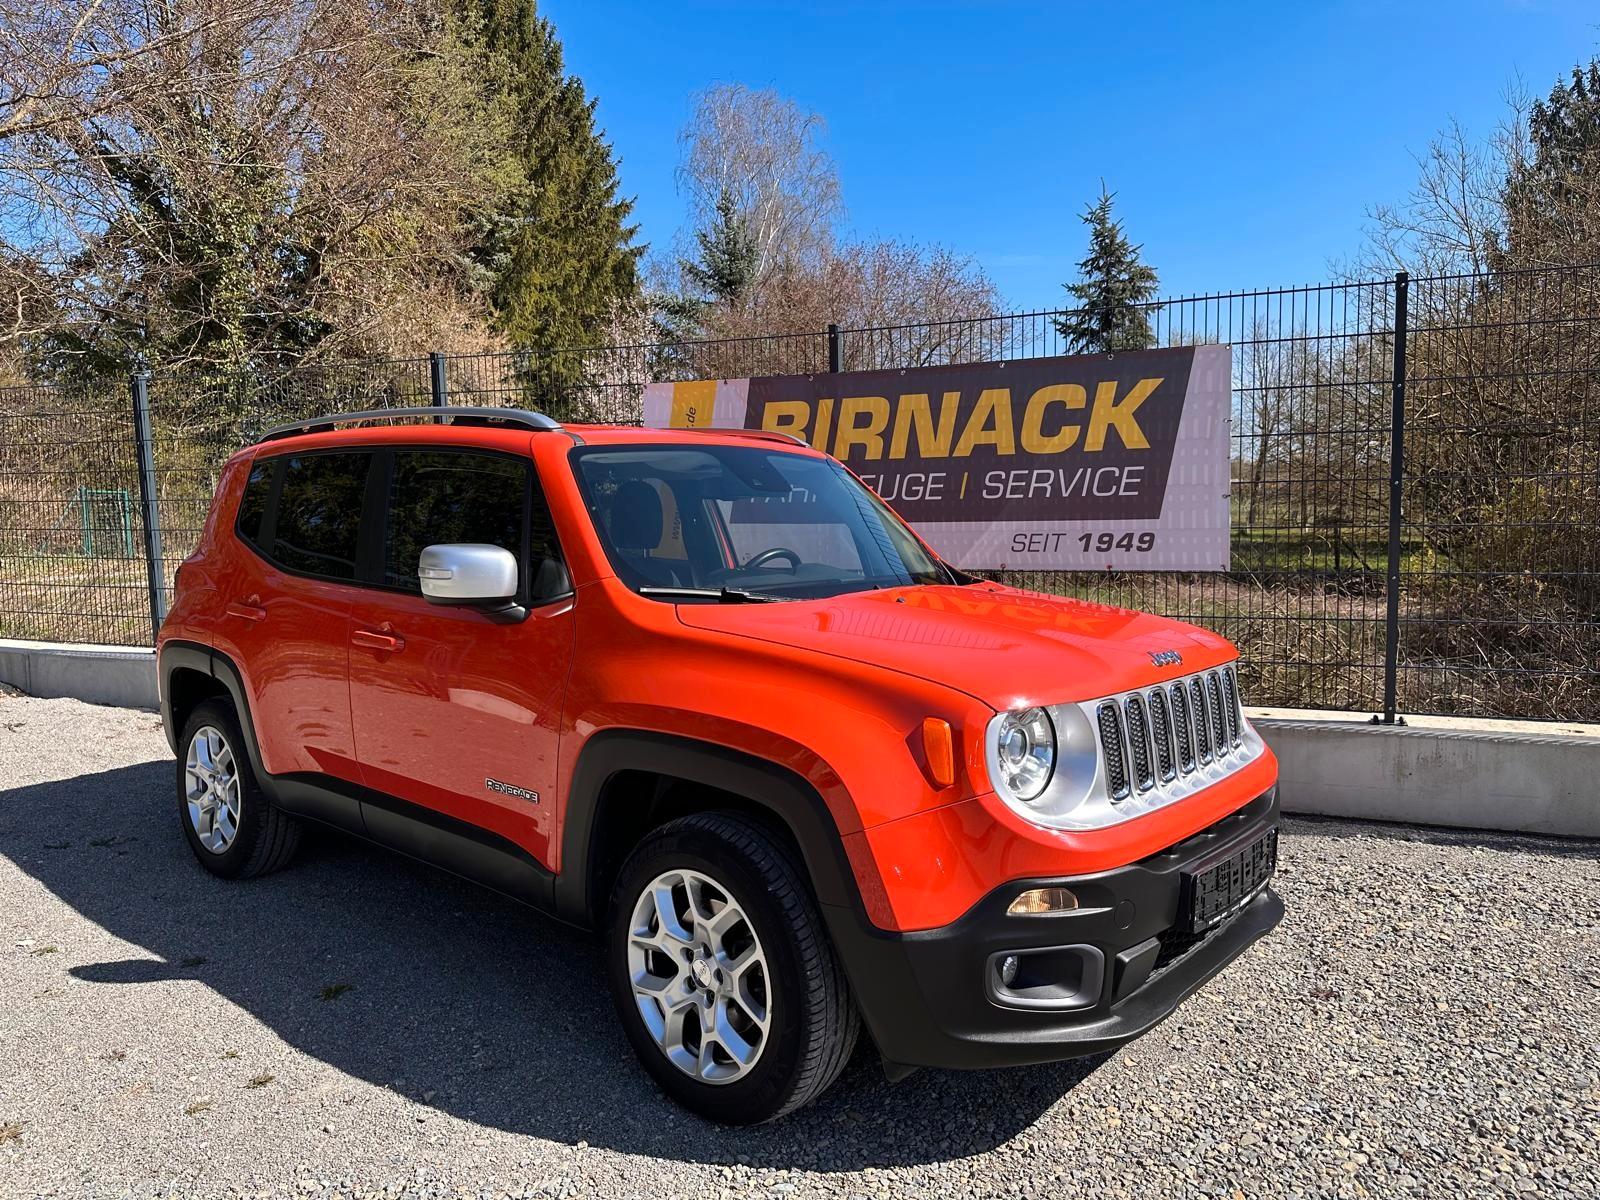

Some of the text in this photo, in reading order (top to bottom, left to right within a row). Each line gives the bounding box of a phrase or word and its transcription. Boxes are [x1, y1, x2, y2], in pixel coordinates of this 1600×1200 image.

[761, 377, 1165, 461] BIRNACK
[982, 466, 1145, 499] SERVICE
[1011, 532, 1156, 553] SEIT 1949
[1147, 650, 1183, 667] Jeep
[485, 777, 540, 804] RENEGADE
